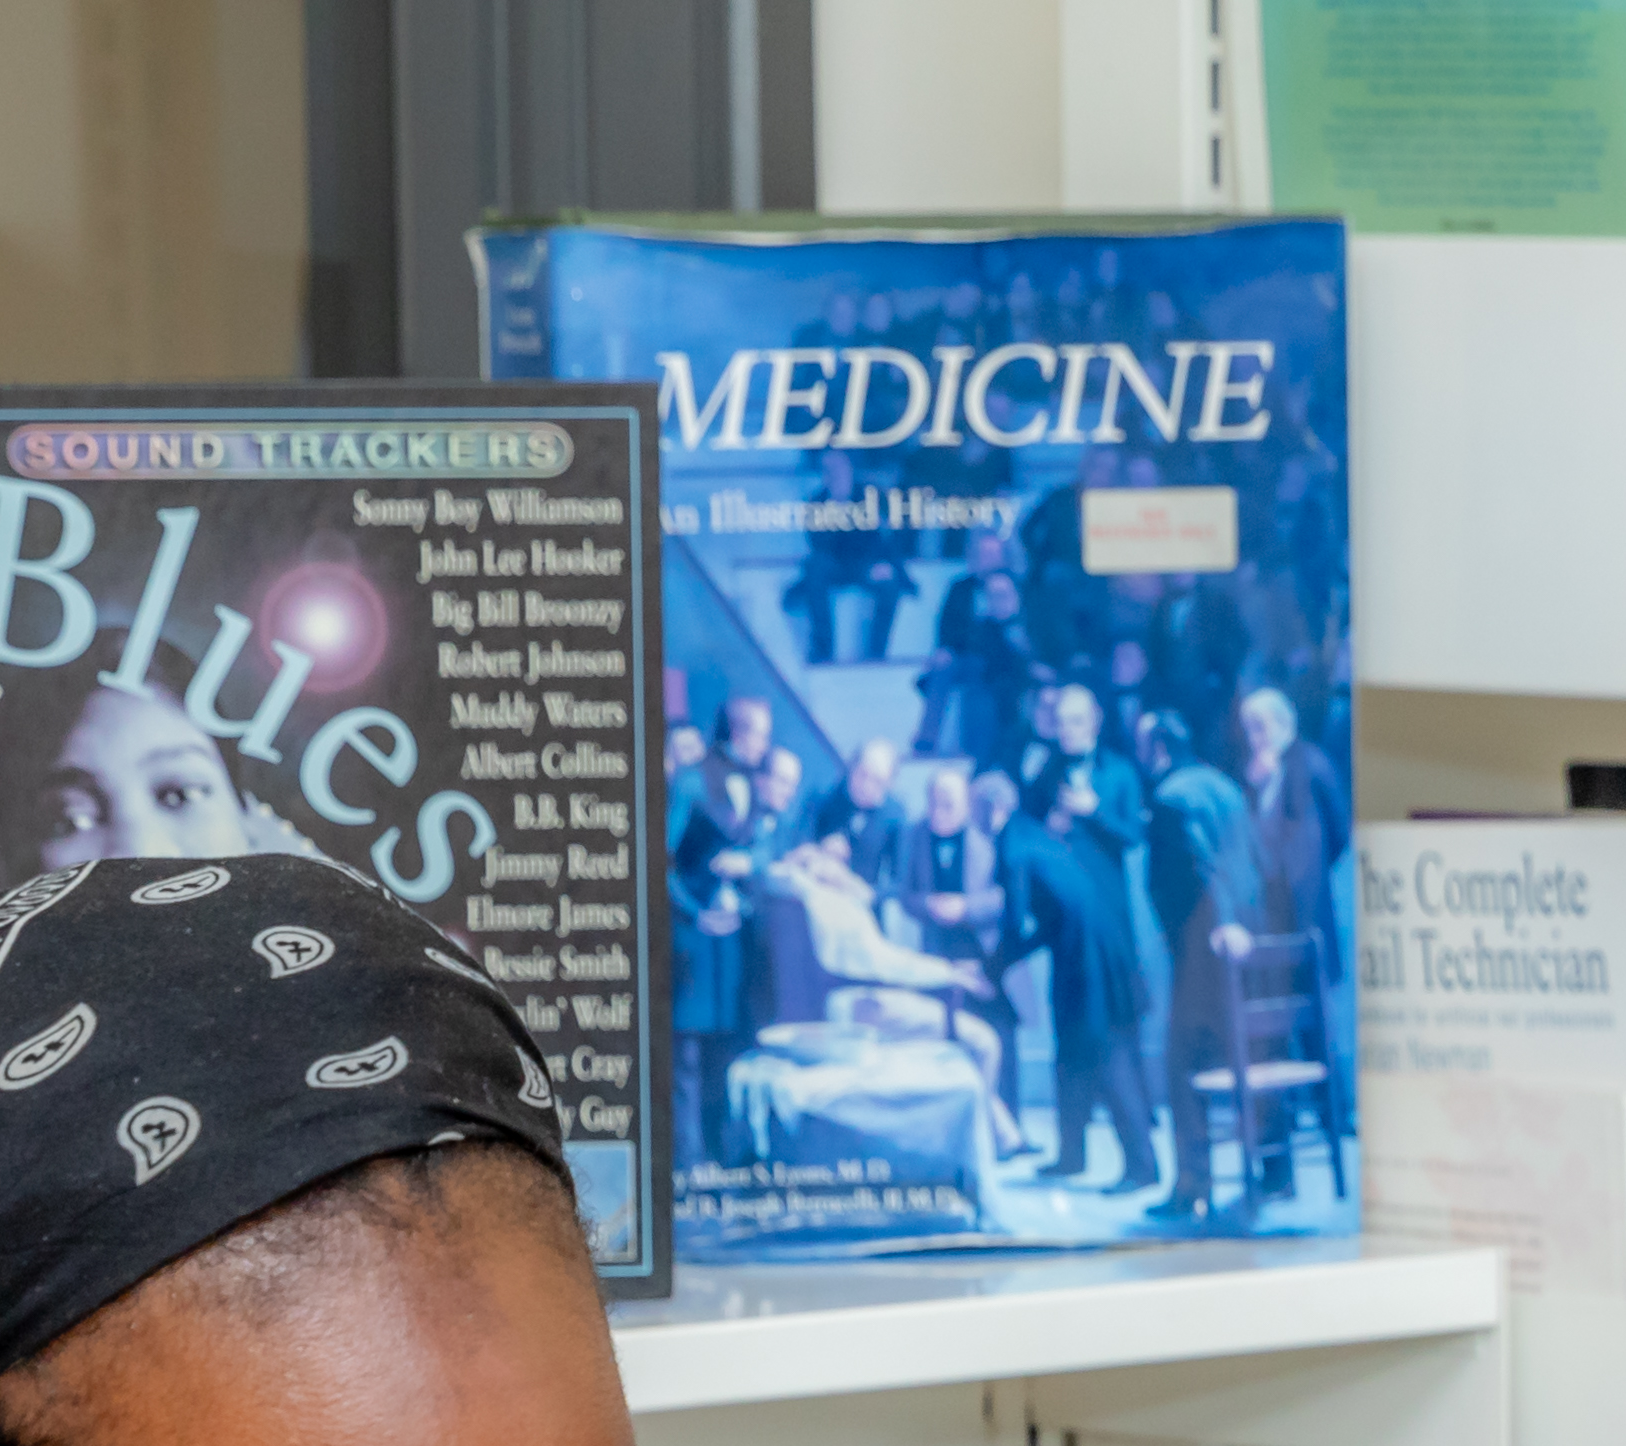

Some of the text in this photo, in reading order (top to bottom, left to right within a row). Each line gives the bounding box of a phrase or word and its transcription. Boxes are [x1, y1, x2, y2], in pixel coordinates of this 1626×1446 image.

[655, 340, 1274, 451] MEDICINE
[24, 430, 559, 470] SOUND TRACKERS
[353, 487, 623, 534] Sonny Boy Williamson
[711, 486, 878, 533] Illustrated
[889, 486, 1021, 539] History
[416, 537, 625, 584] John Lee Hooker
[432, 589, 625, 636] Big Bill Broonzy
[438, 639, 626, 685] Robert Johnson
[450, 691, 628, 737] Muddy Waters
[460, 741, 629, 779] Albert Collins
[514, 793, 630, 837] B.B. King
[480, 842, 630, 888] Jimmy Reed
[1360, 849, 1590, 936] he Complete
[467, 894, 631, 938] Elmore James
[484, 943, 631, 982] Bessie Smith
[1361, 927, 1612, 994] ail Technician
[572, 993, 633, 1031] Wolf
[572, 1046, 633, 1089] Cray
[579, 1095, 633, 1139] Guy
